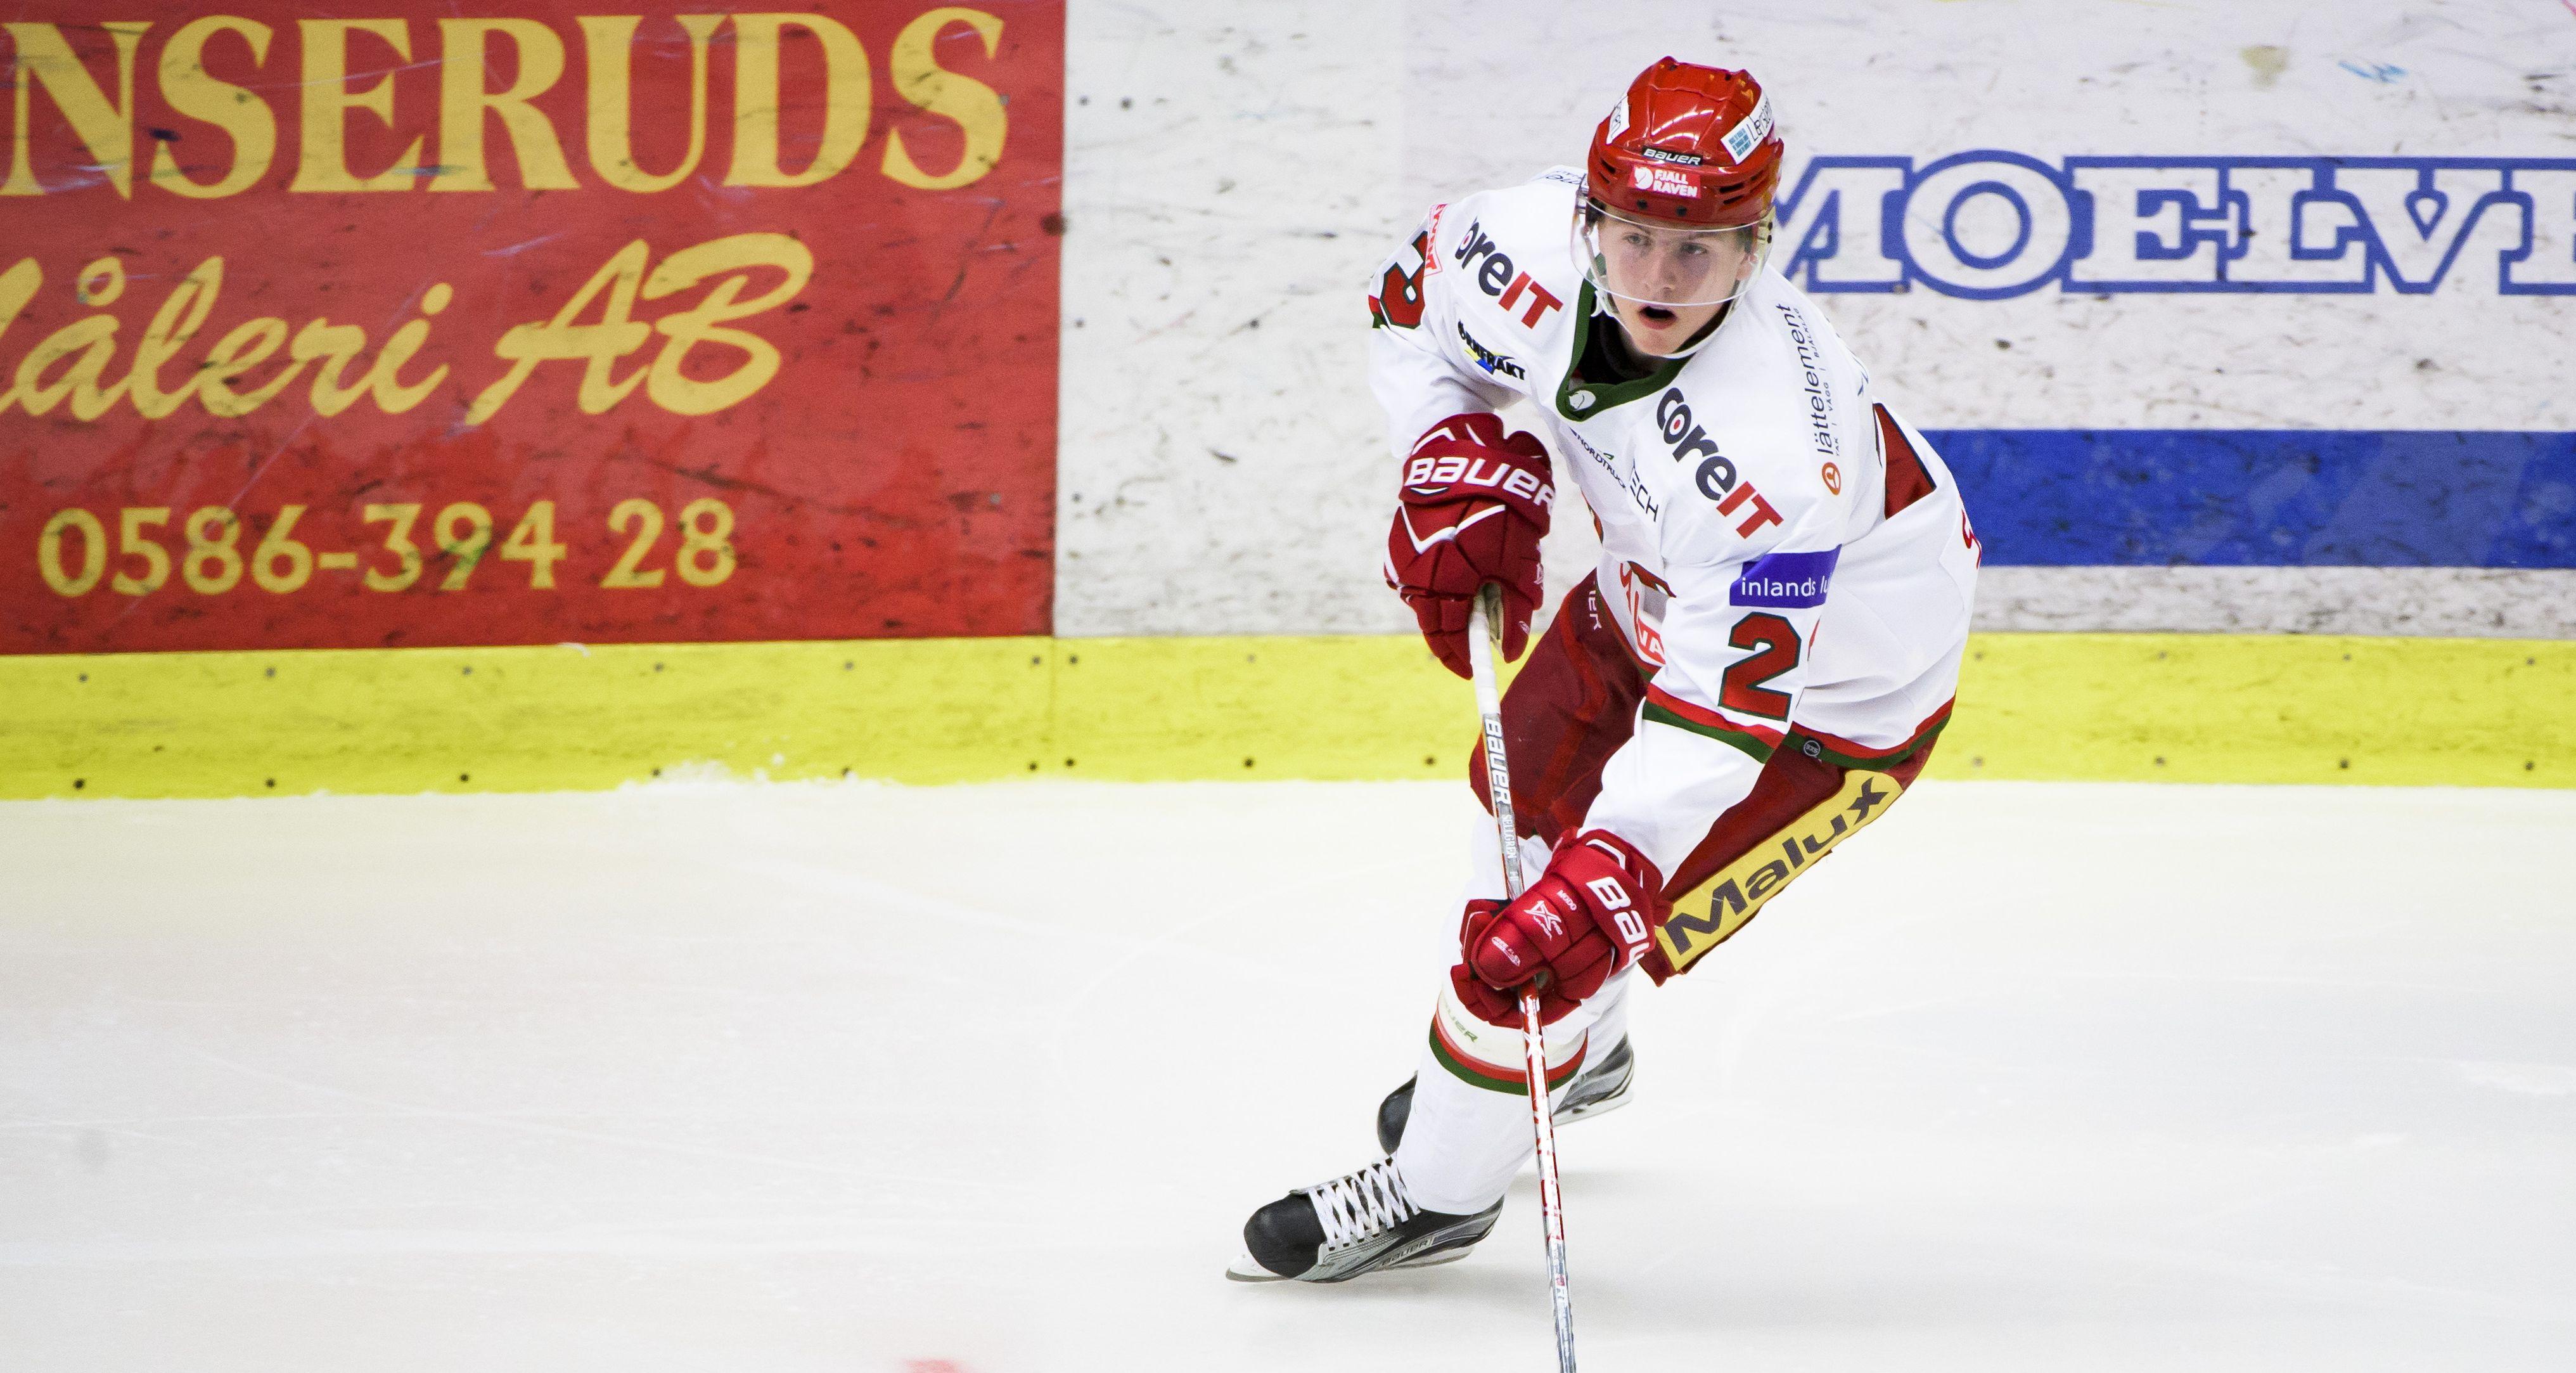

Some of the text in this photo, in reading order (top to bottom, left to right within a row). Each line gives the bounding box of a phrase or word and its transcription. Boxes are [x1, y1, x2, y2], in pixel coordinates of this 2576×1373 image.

[0, 7, 1008, 201] NSERUDS
[1644, 148, 1701, 165] BAUER
[465, 233, 814, 425] AB
[1455, 217, 1563, 330] oreIT
[1776, 303, 1833, 455] lättelement
[38, 498, 736, 596] 0586-394 28
[1741, 577, 1816, 597] inlands
[1718, 611, 1820, 723] 2
[1485, 719, 1511, 804] BAUER
[1664, 777, 1888, 957] Malux
